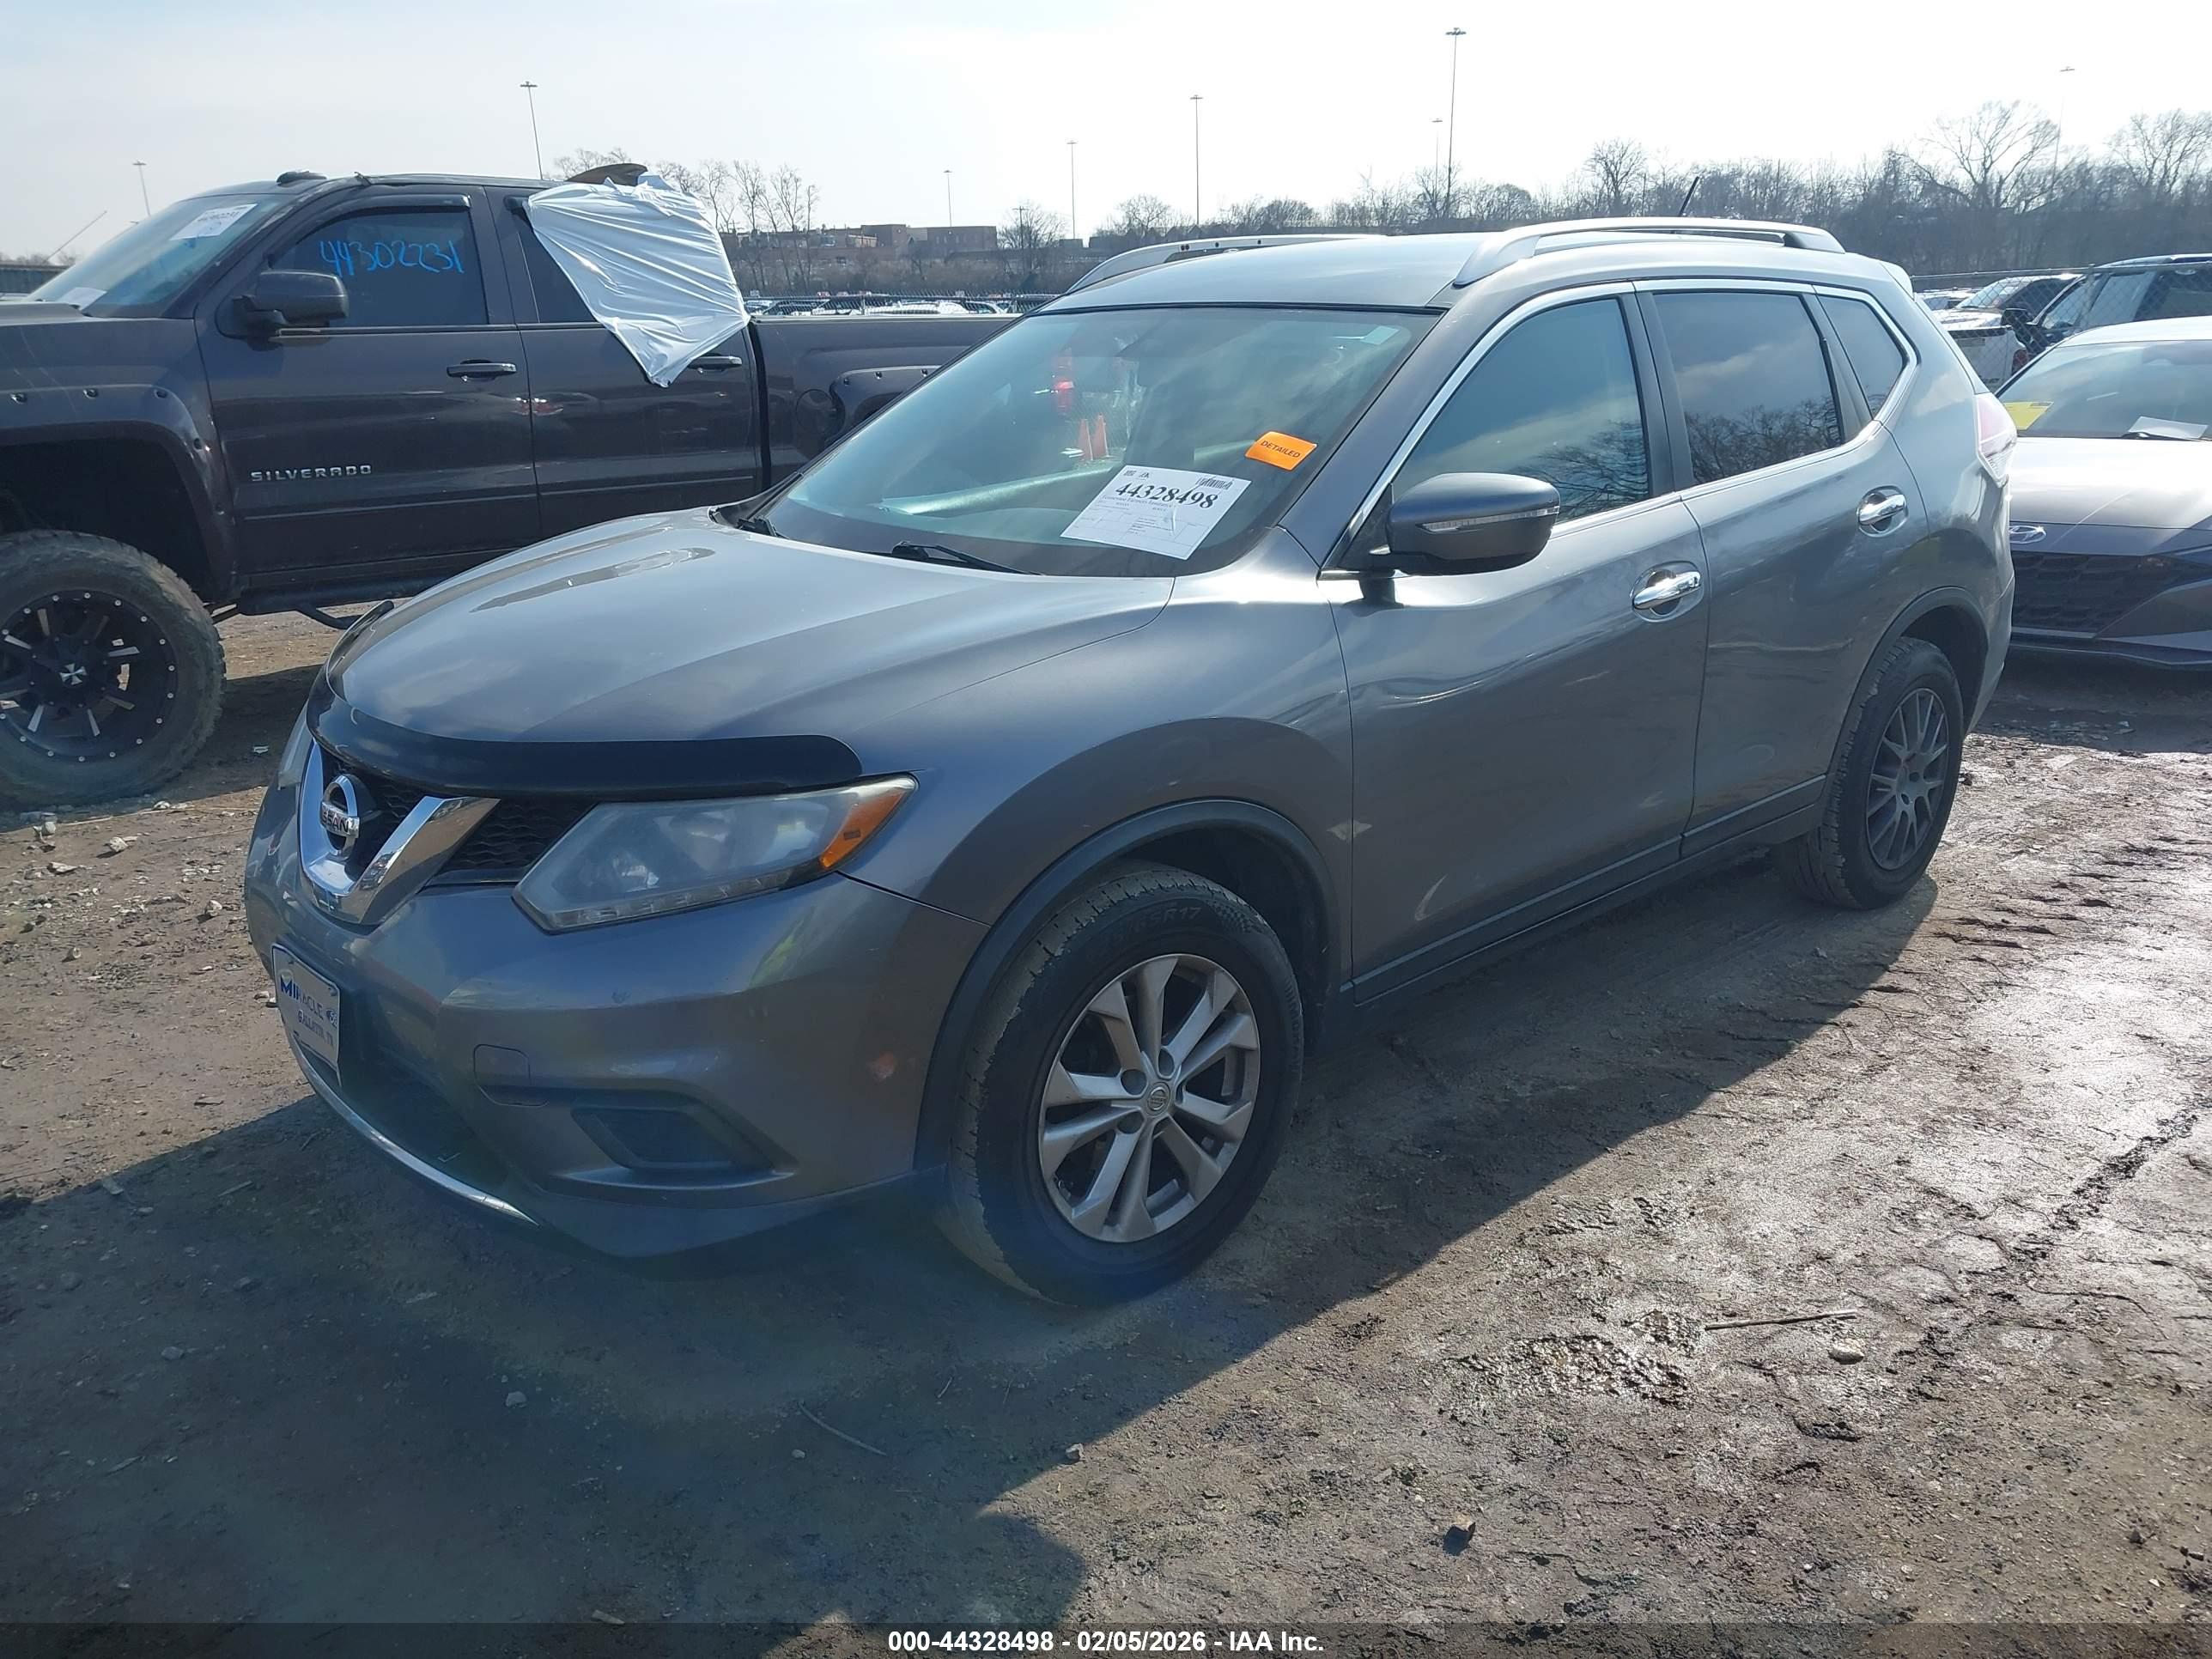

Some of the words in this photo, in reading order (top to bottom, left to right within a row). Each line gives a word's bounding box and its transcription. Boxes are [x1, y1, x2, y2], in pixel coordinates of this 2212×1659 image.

[319, 240, 465, 277] 44302231
[1260, 440, 1302, 459] DETAILED
[250, 465, 372, 482] SILVERADO
[1115, 482, 1218, 509] 44328498
